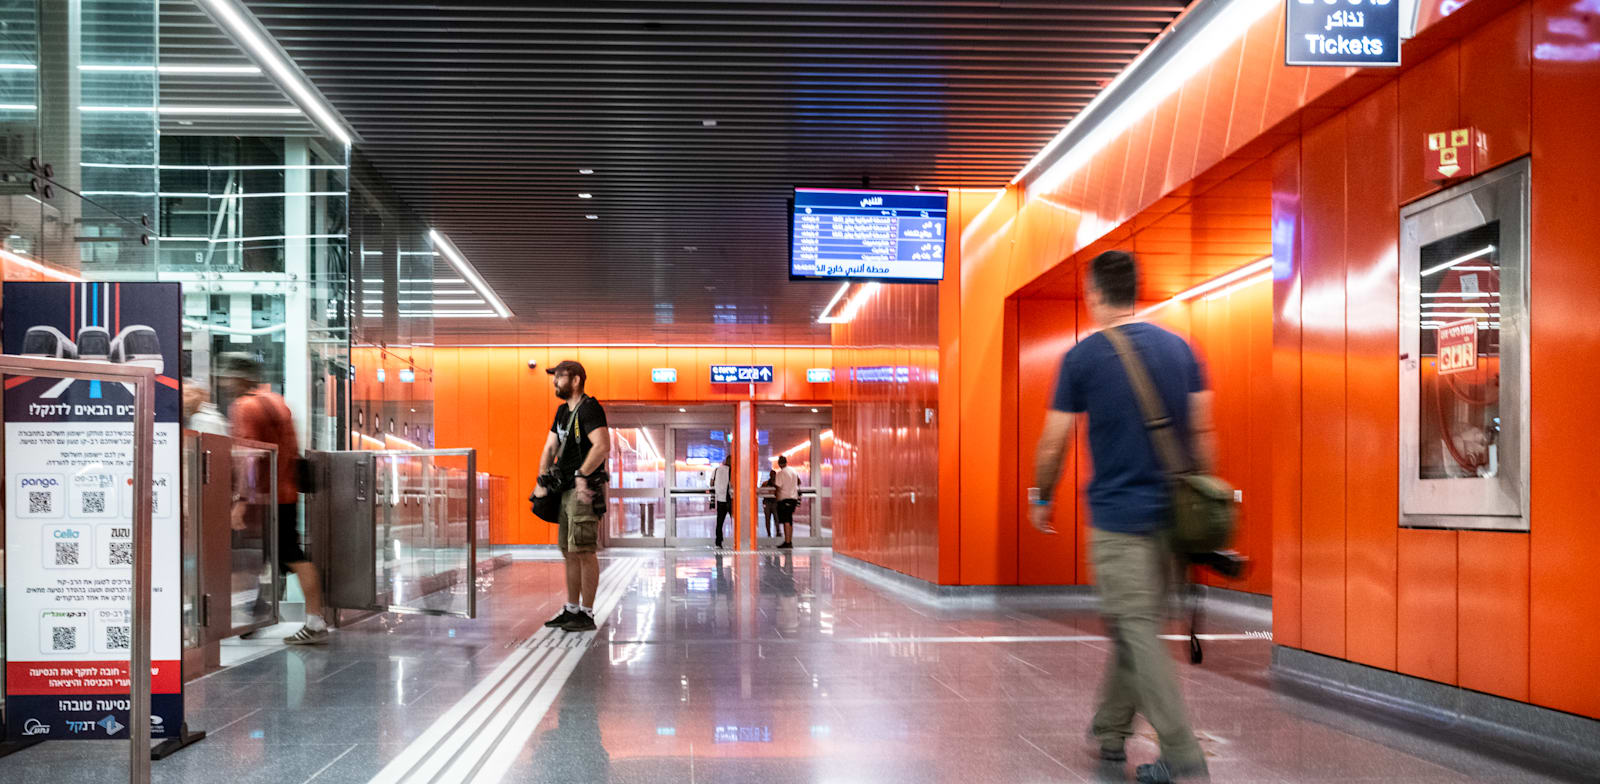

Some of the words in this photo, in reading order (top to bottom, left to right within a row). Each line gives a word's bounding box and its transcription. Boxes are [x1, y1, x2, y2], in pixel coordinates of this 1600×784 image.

[1324, 10, 1364, 31] تذاكر
[1305, 34, 1383, 55] Tickets
[29, 402, 71, 417] לדנקל!
[75, 404, 113, 416] הבאים
[111, 528, 130, 538] ZUZU
[29, 668, 59, 676] הנסיעה
[60, 668, 74, 676] את
[75, 667, 98, 678] לתקף
[100, 668, 120, 676] חובה
[49, 679, 82, 687] והיציאה!
[83, 679, 113, 687] הכניסה
[59, 700, 92, 711] טובה!
[96, 700, 131, 711] נסיעה
[65, 719, 96, 734] דנקל
